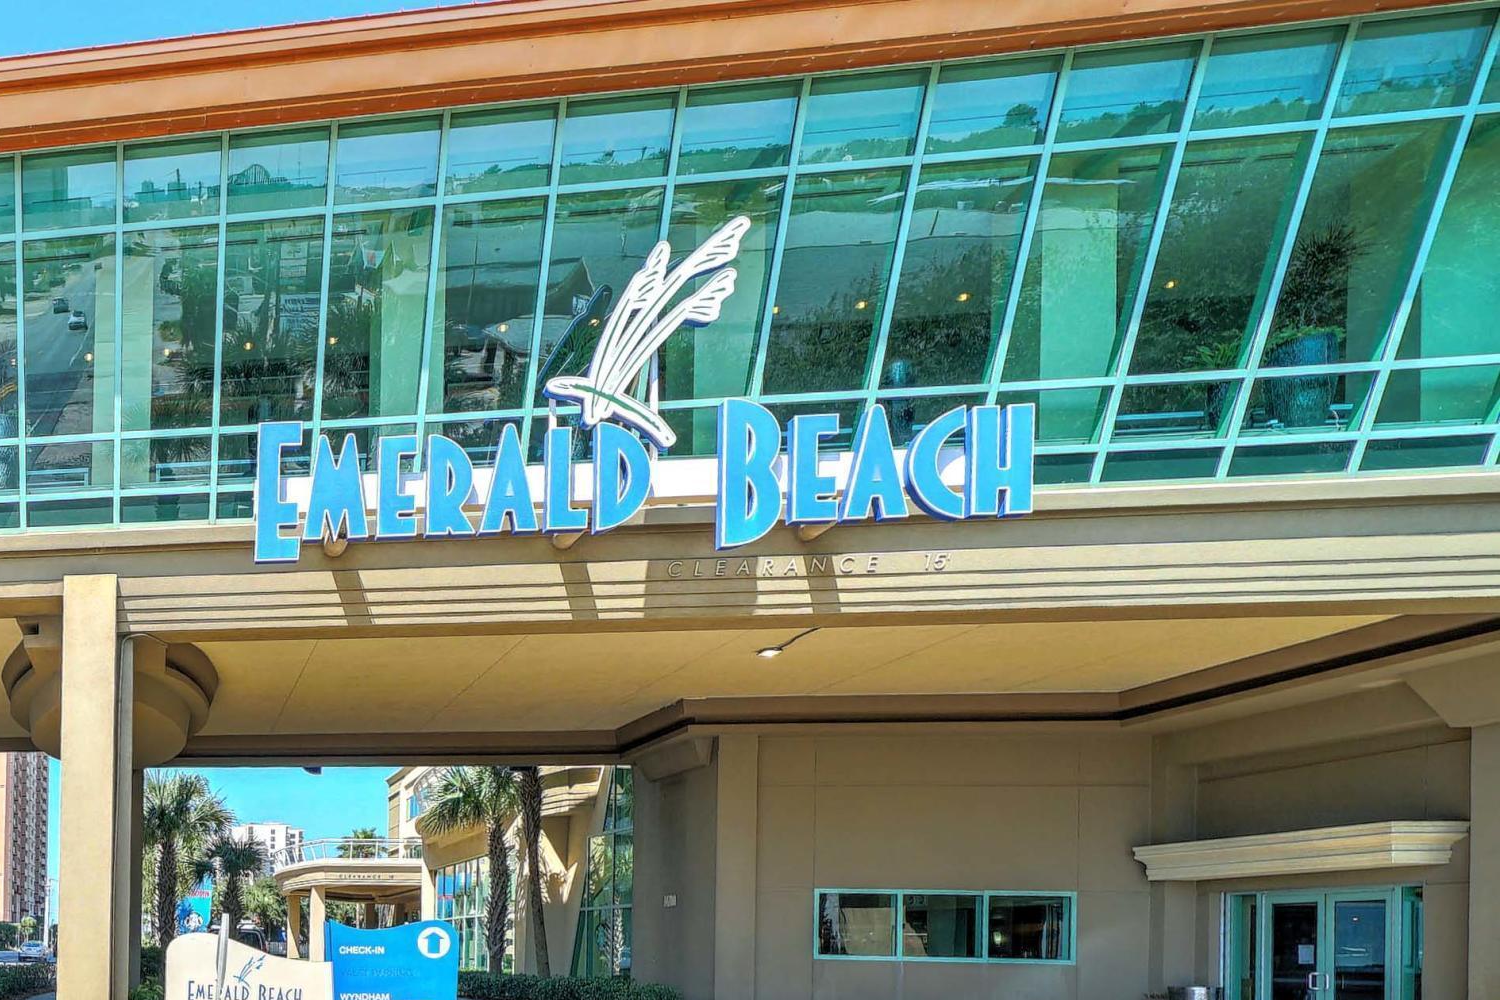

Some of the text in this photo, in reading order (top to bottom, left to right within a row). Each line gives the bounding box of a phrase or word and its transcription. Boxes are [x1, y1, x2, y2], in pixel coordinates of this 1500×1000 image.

[254, 399, 1036, 564] EMERALD BEACH
[667, 554, 881, 577] CLEARANCE
[339, 946, 385, 955] CHECK-IN
